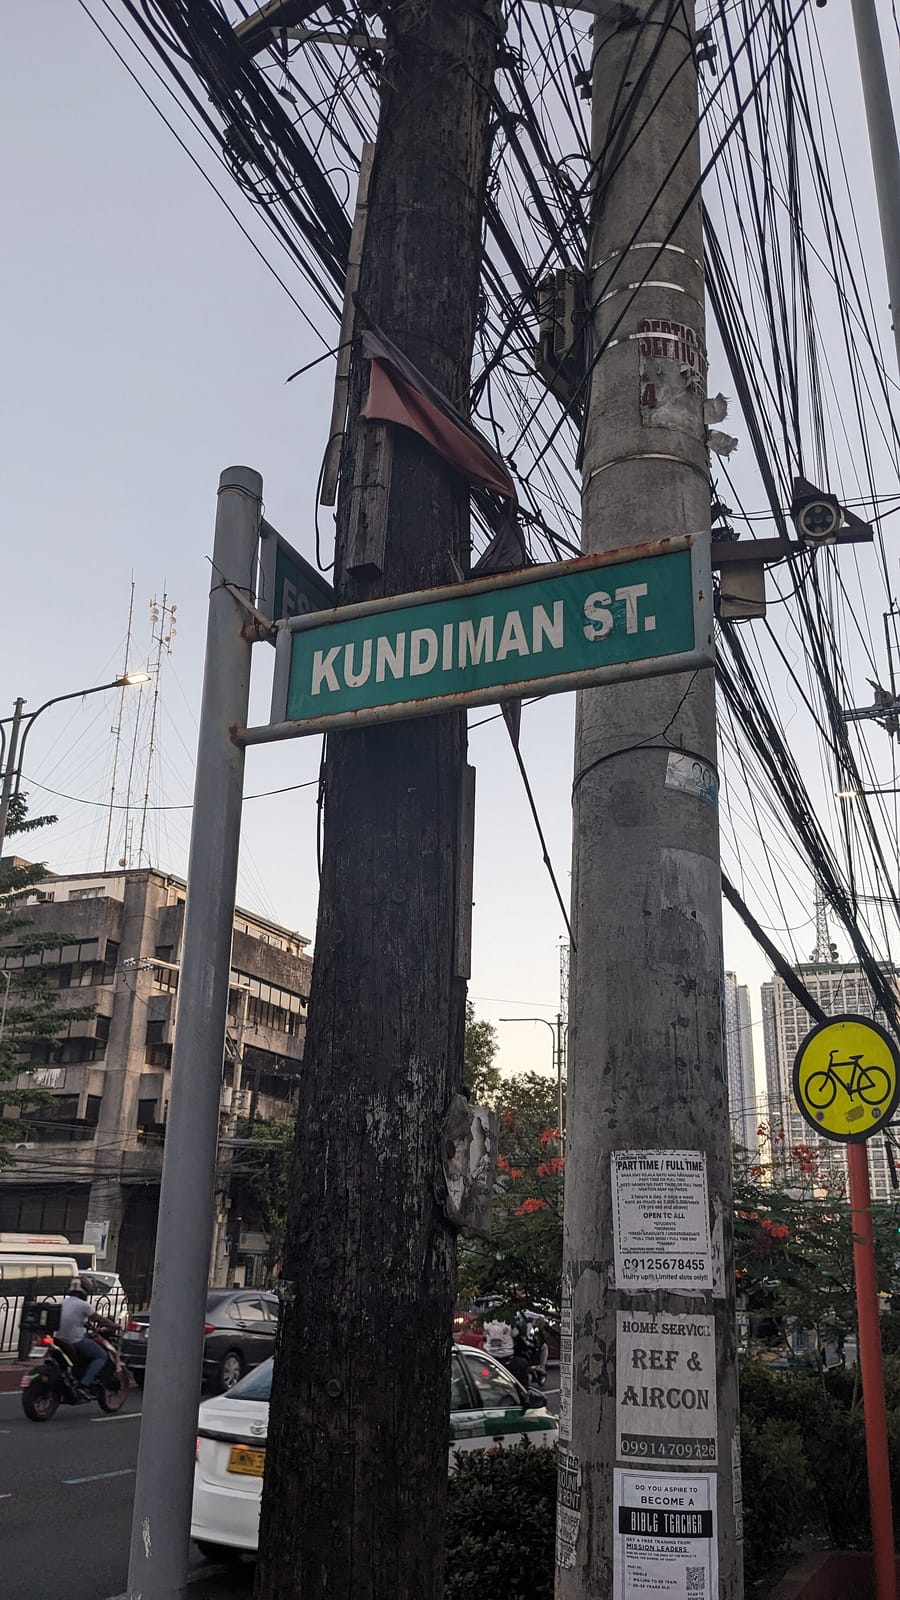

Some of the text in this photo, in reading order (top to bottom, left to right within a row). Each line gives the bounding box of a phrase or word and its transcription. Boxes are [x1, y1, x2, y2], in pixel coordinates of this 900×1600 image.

[311, 583, 656, 695] KUNDIMAN ST.
[618, 1160, 637, 1170] PART
[638, 1160, 659, 1170] TIME
[666, 1160, 684, 1170] FULL
[685, 1161, 704, 1171] TIME
[624, 1258, 704, 1270] 09125678455
[622, 1320, 658, 1334] HOME
[632, 1348, 703, 1372] REF &
[621, 1385, 709, 1410] AIRCON
[622, 1440, 715, 1458] 09914709726
[641, 1496, 694, 1506] BECOME A
[631, 1512, 702, 1534] BIBLE TEACHER
[626, 1543, 654, 1551] MISSION
